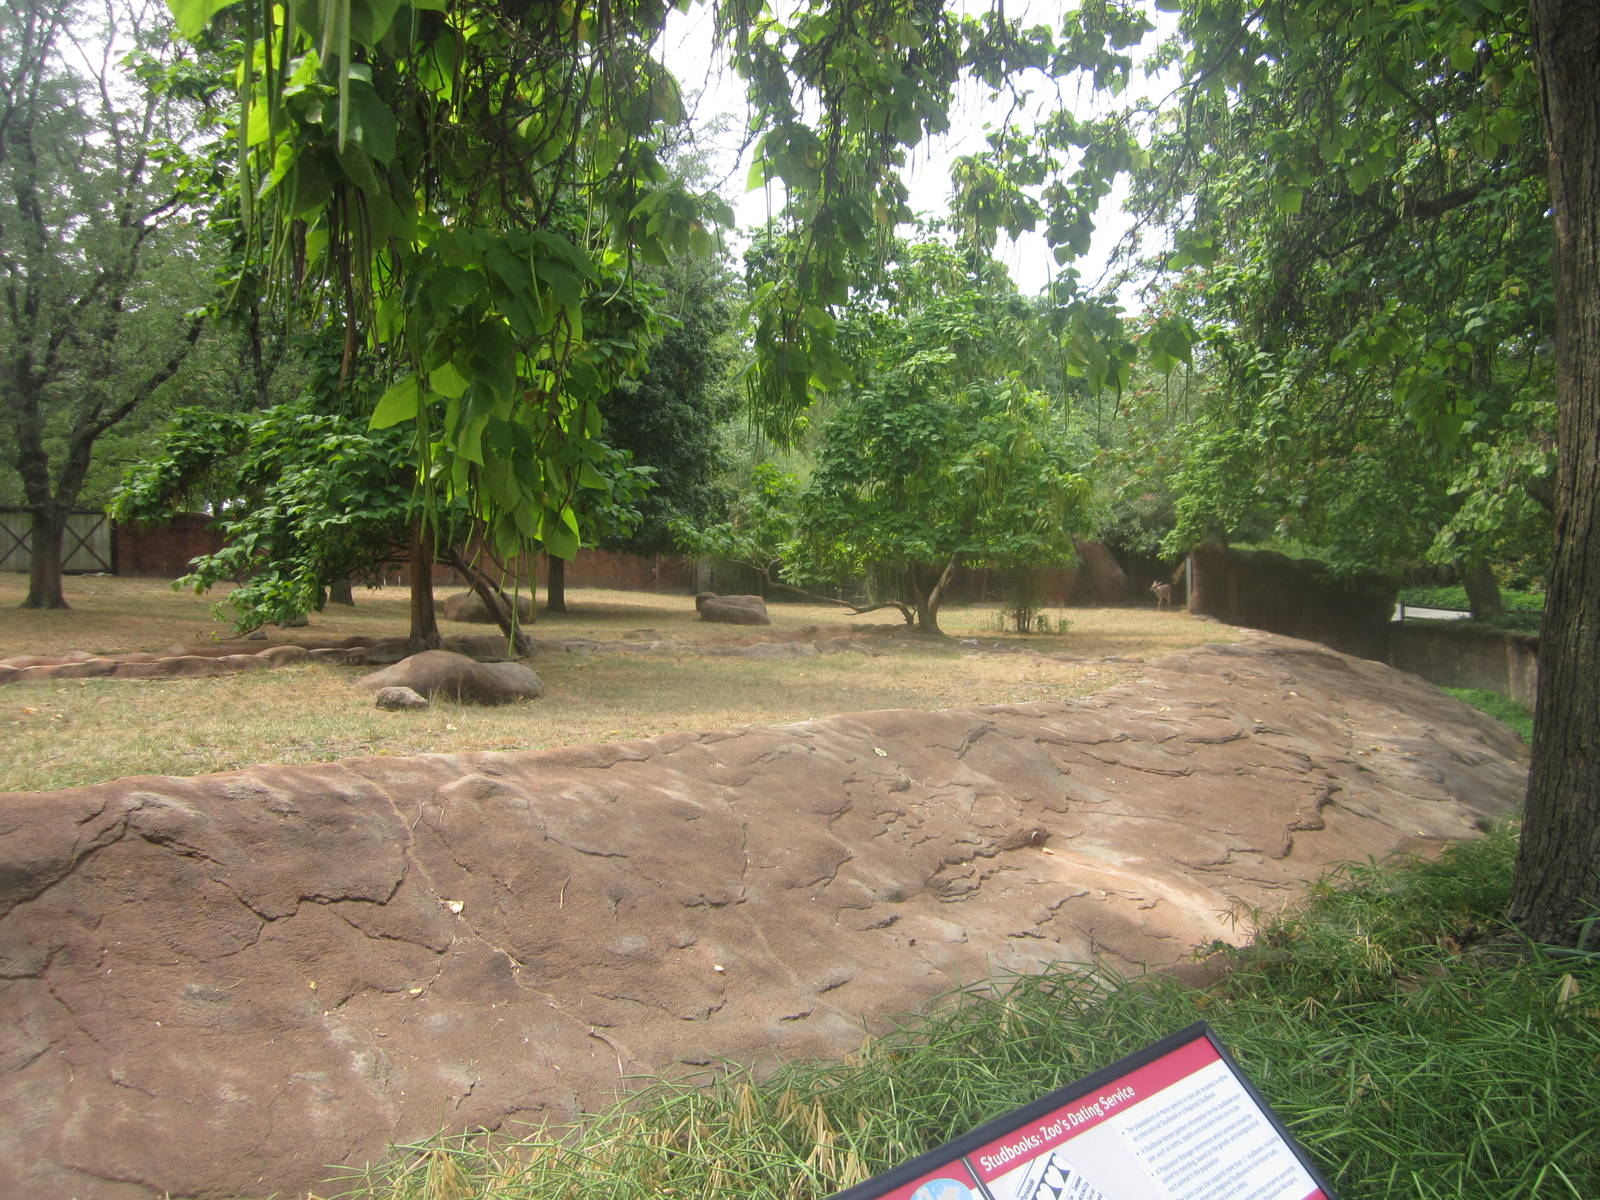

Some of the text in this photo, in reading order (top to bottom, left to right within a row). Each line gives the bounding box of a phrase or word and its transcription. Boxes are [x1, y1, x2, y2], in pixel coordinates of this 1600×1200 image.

[980, 1085, 1135, 1172] Studbooks: Zoo's Dating Service
